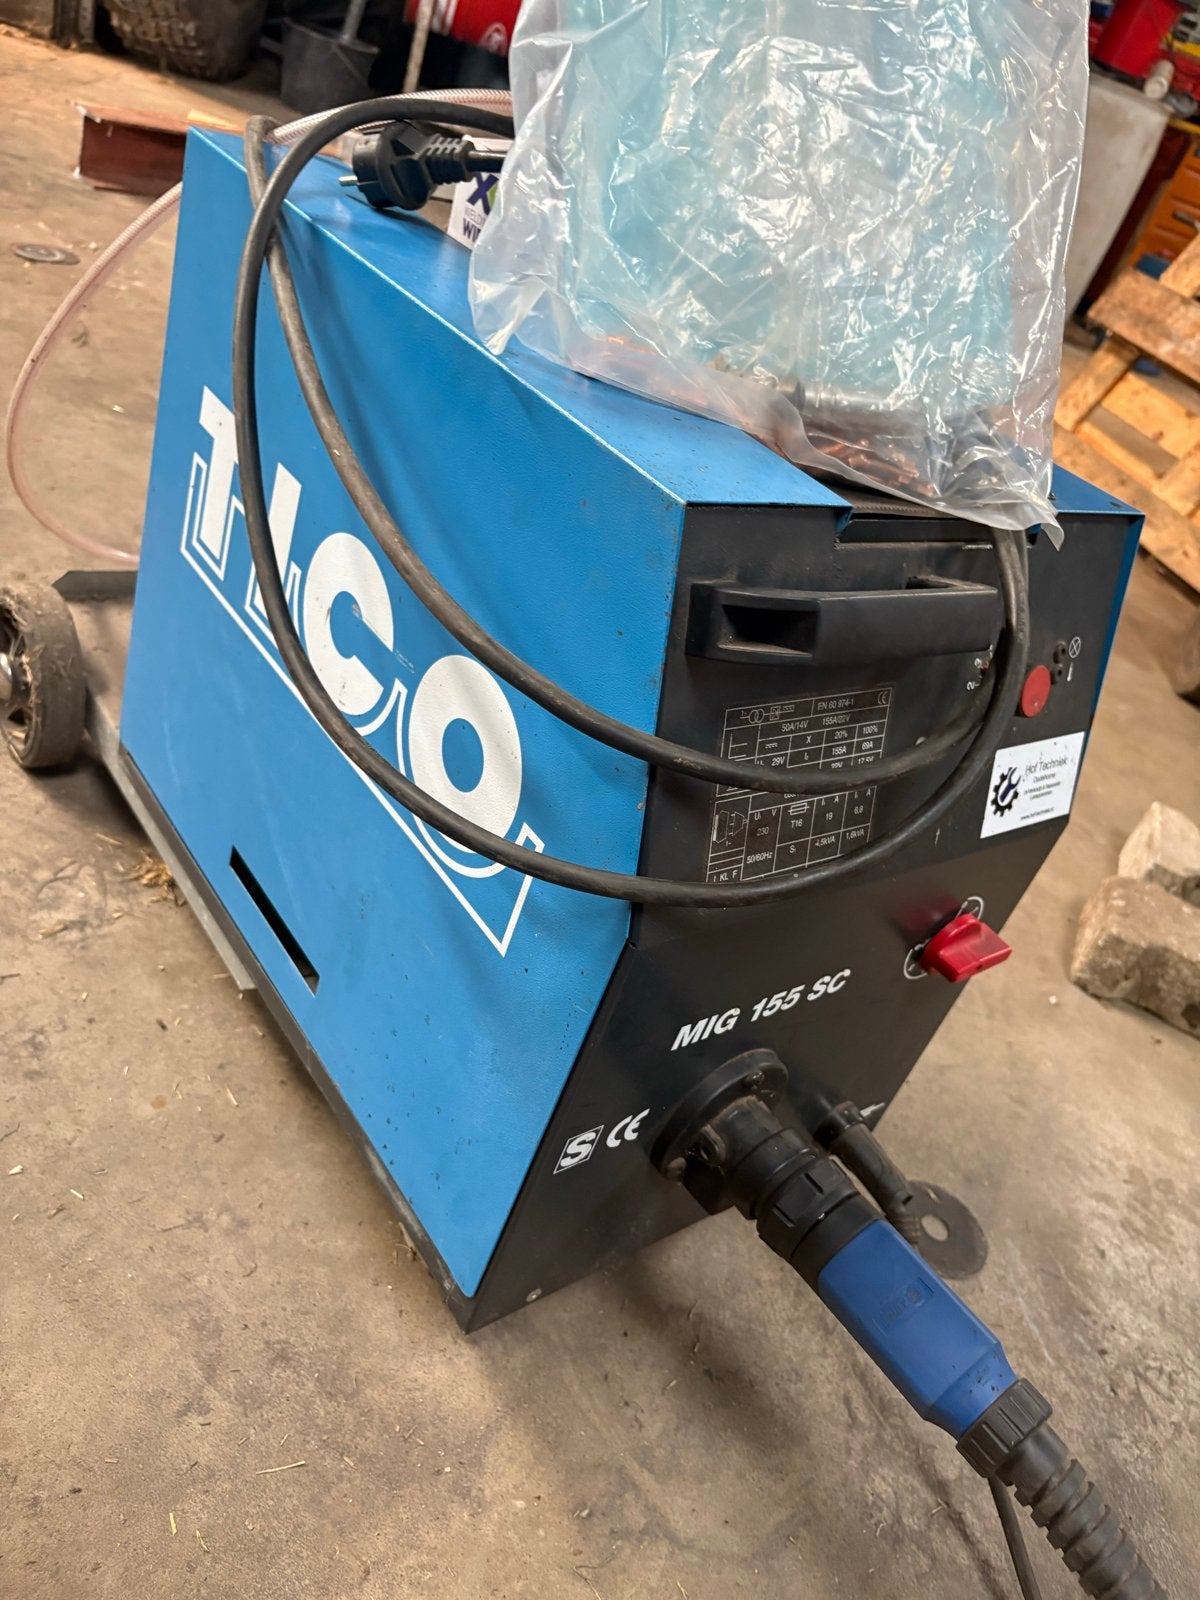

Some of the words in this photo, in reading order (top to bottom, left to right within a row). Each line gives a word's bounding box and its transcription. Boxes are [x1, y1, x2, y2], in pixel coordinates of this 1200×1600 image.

[817, 701, 828, 710] EN
[828, 700, 837, 709] 60
[781, 720, 809, 733] 50A/14V
[806, 735, 812, 744] X
[834, 730, 849, 740] 20%
[862, 725, 878, 735] 100%
[832, 745, 847, 755] 155A
[771, 756, 785, 767] 29V
[825, 812, 833, 821] 19
[791, 819, 803, 829] T16
[756, 827, 769, 837] 230
[746, 851, 773, 864] 50/60Hz
[720, 872, 729, 881] KL
[671, 1007, 741, 1051] MIG
[751, 984, 806, 1022] 155
[807, 968, 851, 1001] SC
[560, 1132, 597, 1167] S
[606, 1108, 650, 1148] CE
